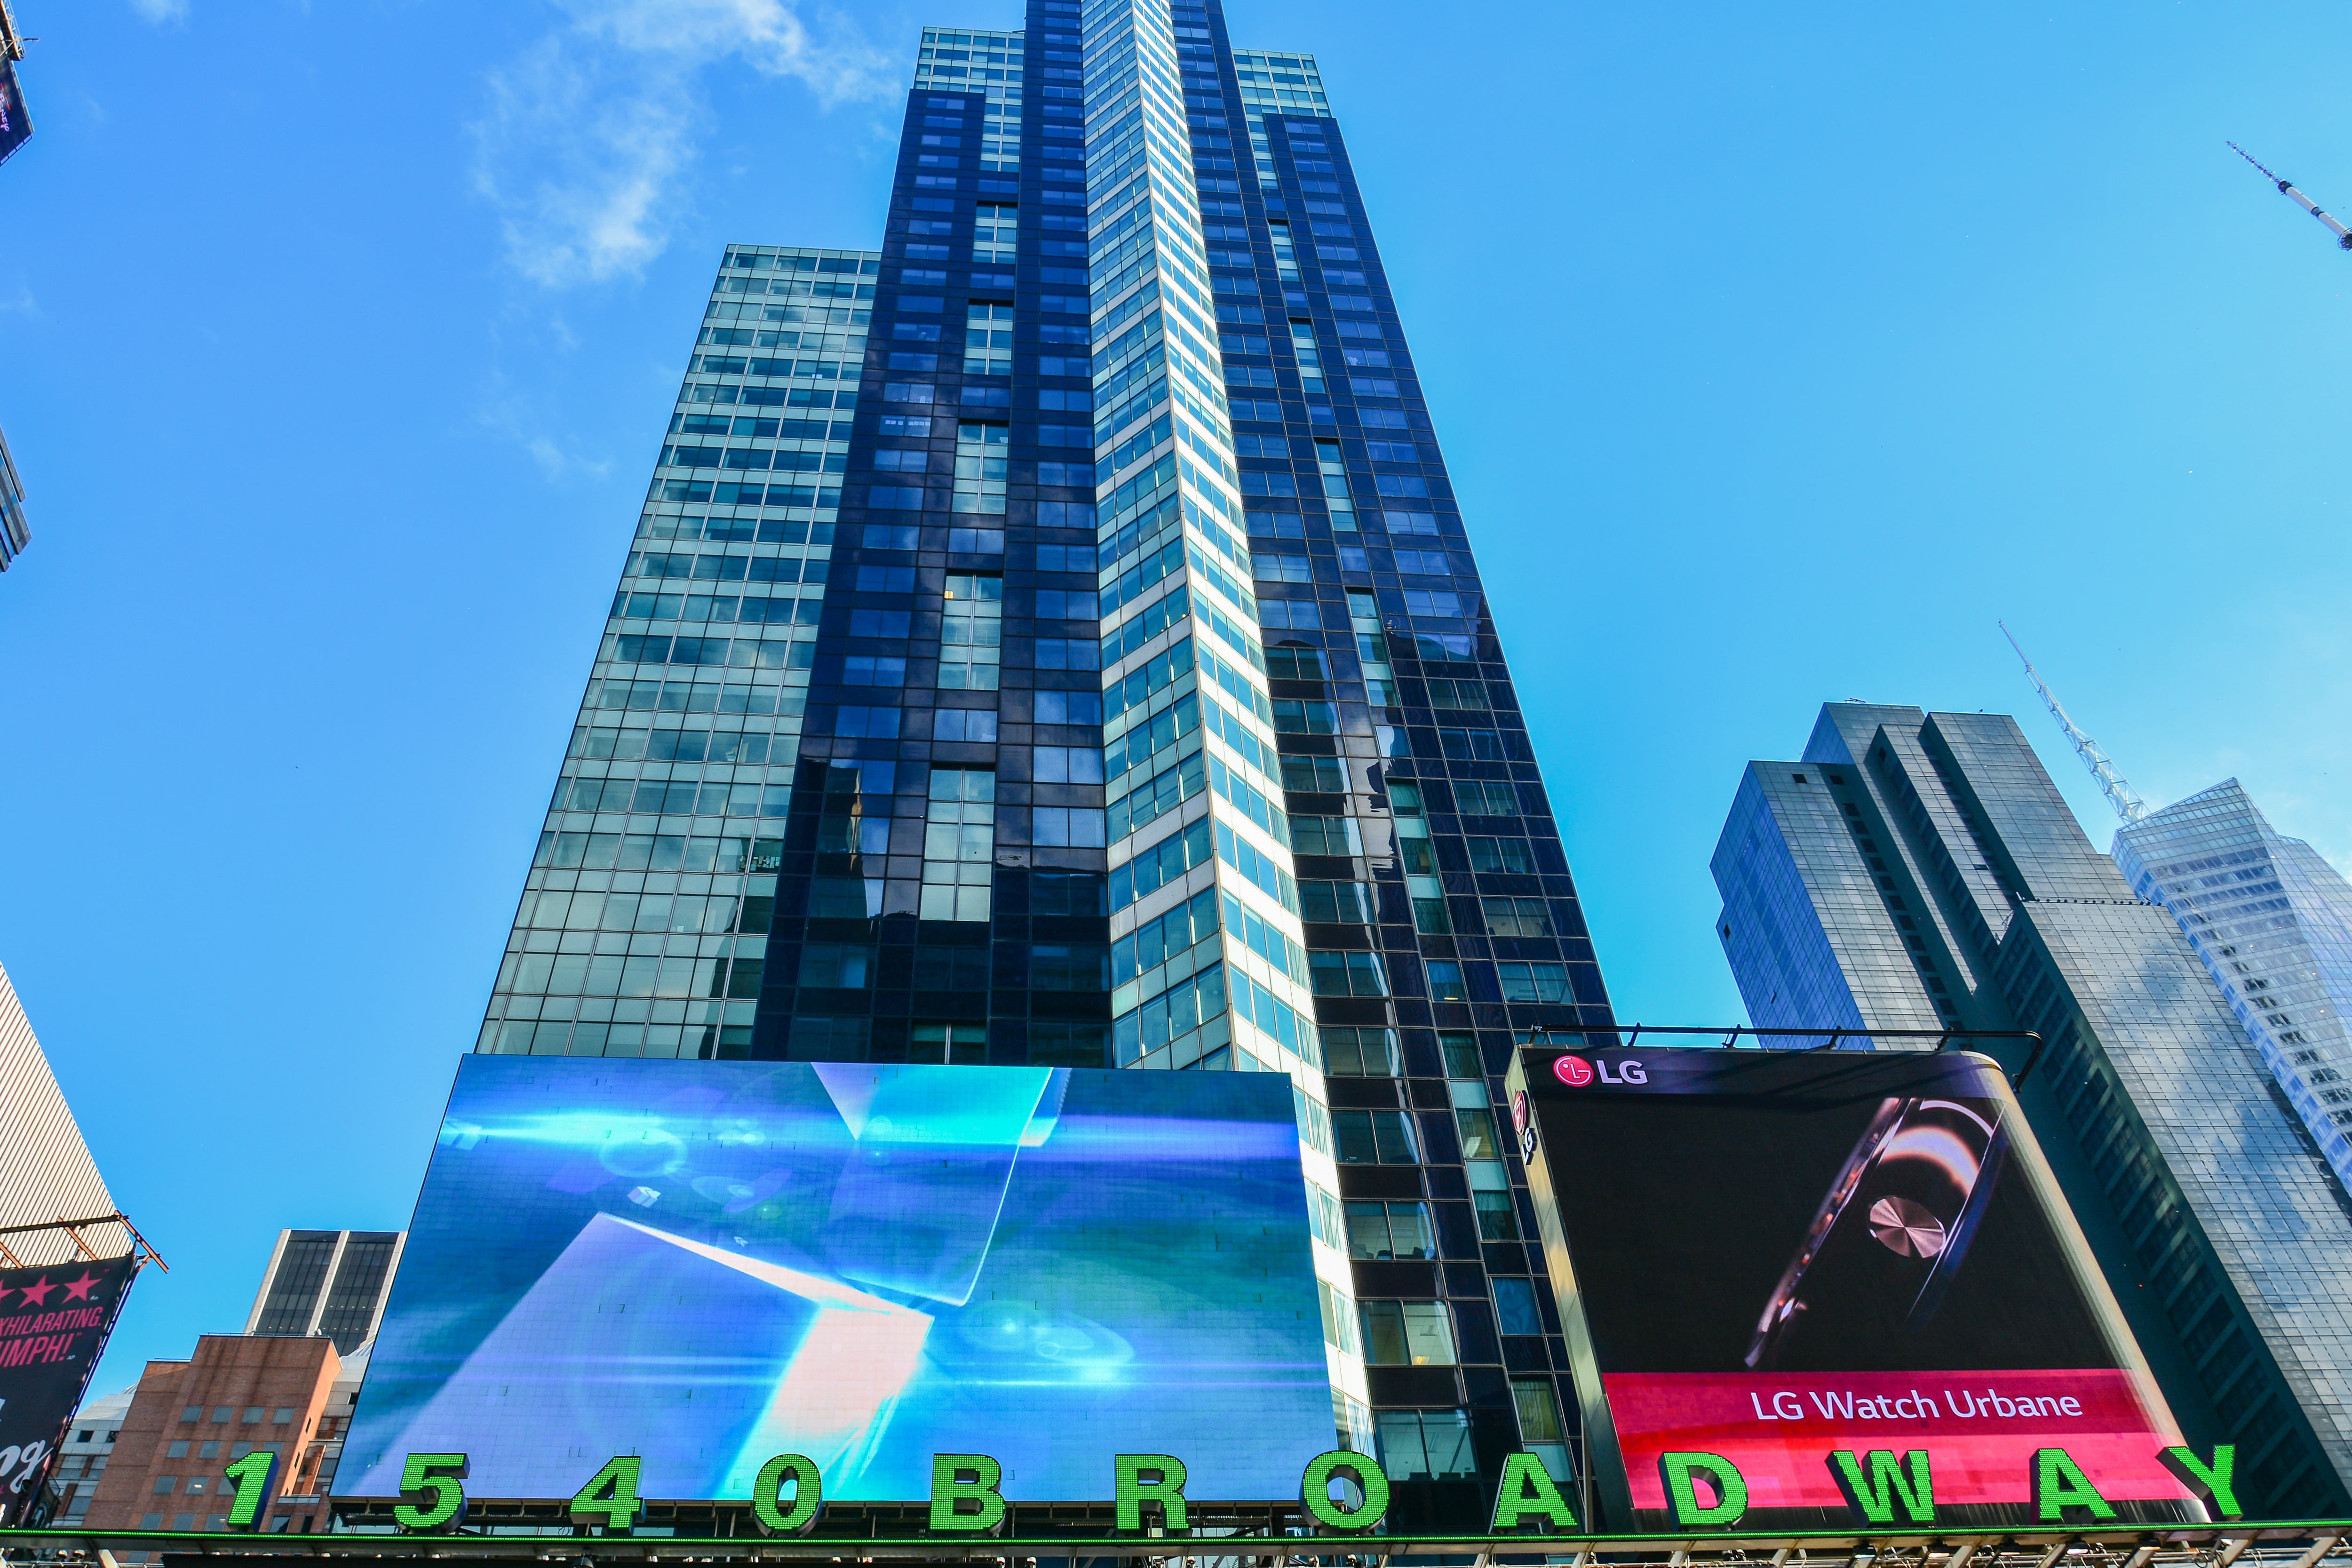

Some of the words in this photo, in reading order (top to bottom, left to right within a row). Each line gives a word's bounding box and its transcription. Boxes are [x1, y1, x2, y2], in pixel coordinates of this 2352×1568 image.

[1596, 1060, 1648, 1084] LG
[1521, 1127, 1534, 1166] LG
[1750, 1392, 1804, 1420] LG
[1809, 1389, 1940, 1419] Watch
[1944, 1389, 2083, 1417] Urbane
